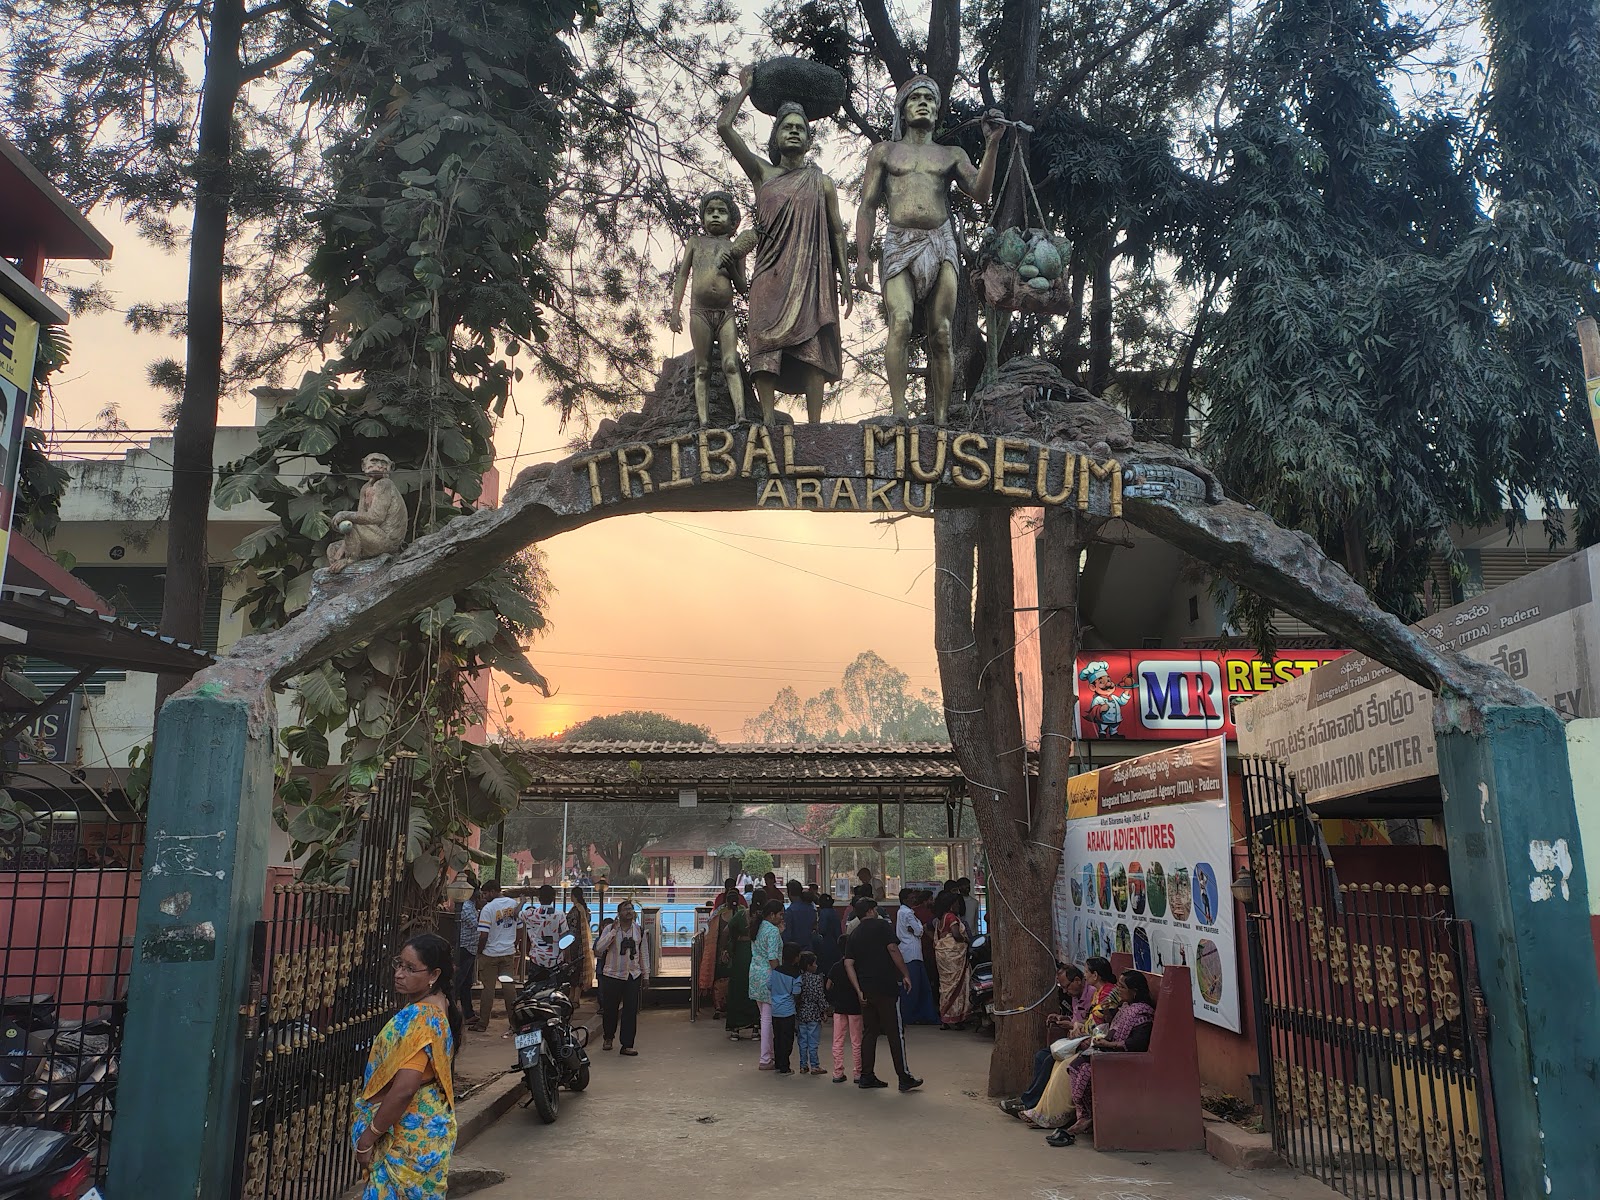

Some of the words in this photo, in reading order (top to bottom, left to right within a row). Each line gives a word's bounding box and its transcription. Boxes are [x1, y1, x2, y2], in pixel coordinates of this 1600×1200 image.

[573, 425, 825, 505] TRIBAL
[863, 424, 1123, 518] MUSEUM
[758, 478, 932, 512] ARAKU
[1316, 682, 1348, 702] Integrated
[1350, 673, 1370, 689] Tribal
[1458, 623, 1491, 646] (ITDA)
[1500, 606, 1540, 629] Paderu
[1142, 671, 1221, 720] MR
[1227, 660, 1337, 691] REST
[1368, 735, 1423, 776] CENTER
[1101, 793, 1120, 809] Integrated
[1120, 790, 1131, 804] Tribal
[1131, 786, 1157, 803] Development
[1158, 784, 1176, 800] Agency
[1176, 779, 1194, 797] (ITDA)
[1198, 776, 1220, 792] Paderu
[1087, 830, 1111, 852] ARAKU
[1113, 823, 1176, 851] ADVENTURES
